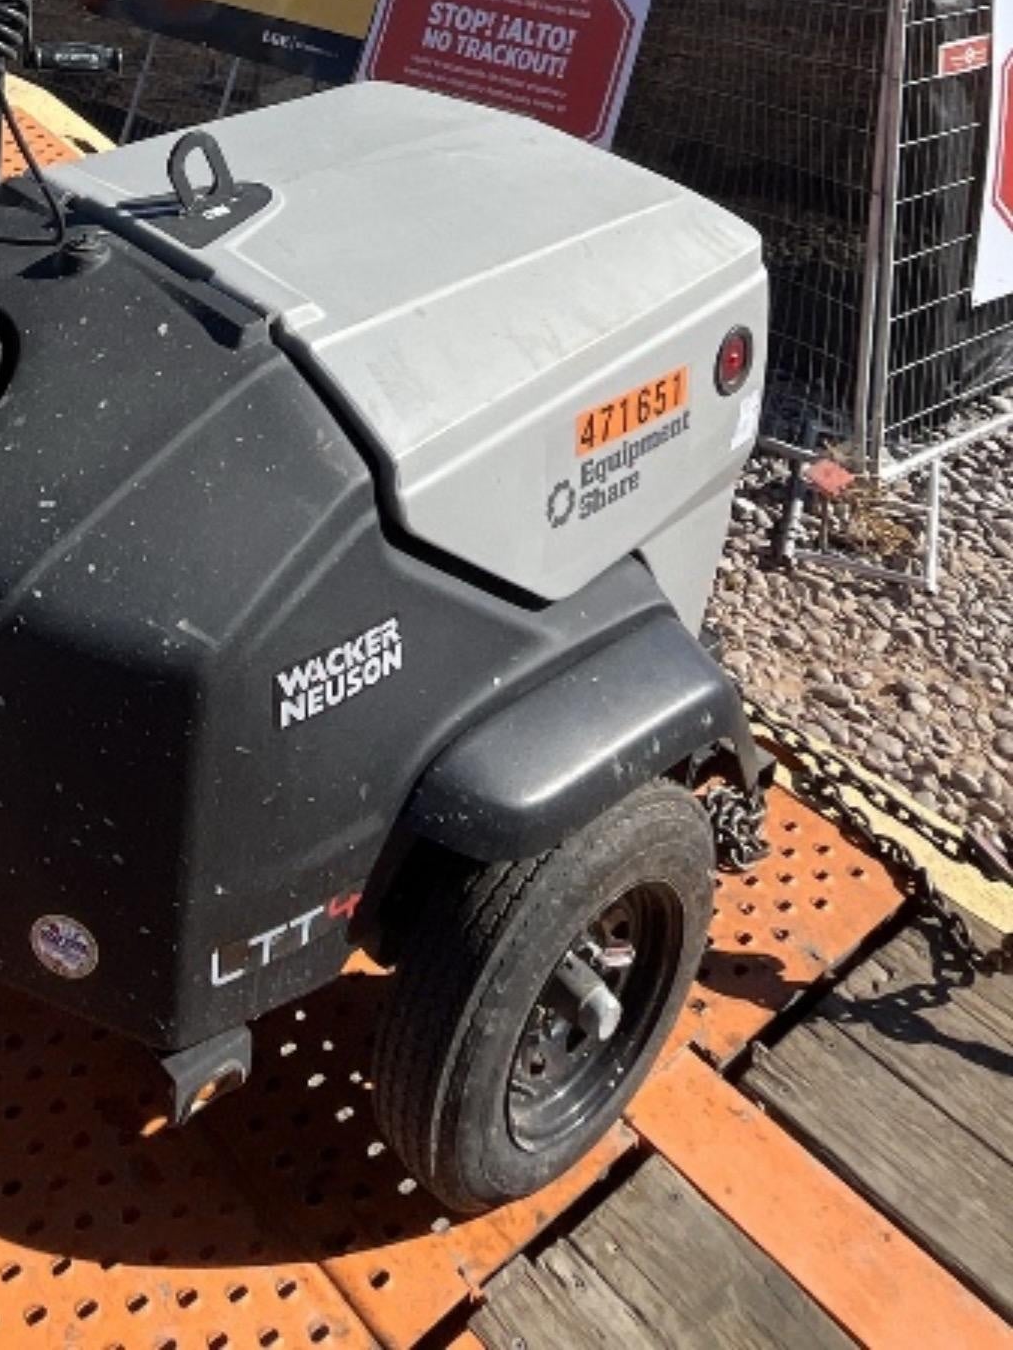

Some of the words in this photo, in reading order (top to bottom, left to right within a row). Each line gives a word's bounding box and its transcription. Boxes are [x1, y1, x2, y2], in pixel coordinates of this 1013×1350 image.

[422, 30, 451, 53] NO
[457, 36, 568, 79] TRACKOUT!
[428, 1, 495, 37] STOP!
[497, 15, 577, 53] ¡ALTO!
[580, 372, 682, 449] 471651
[580, 410, 691, 488] Equipment
[578, 471, 640, 520] Share
[276, 616, 402, 697] WACKER
[279, 642, 403, 731] NEUSON
